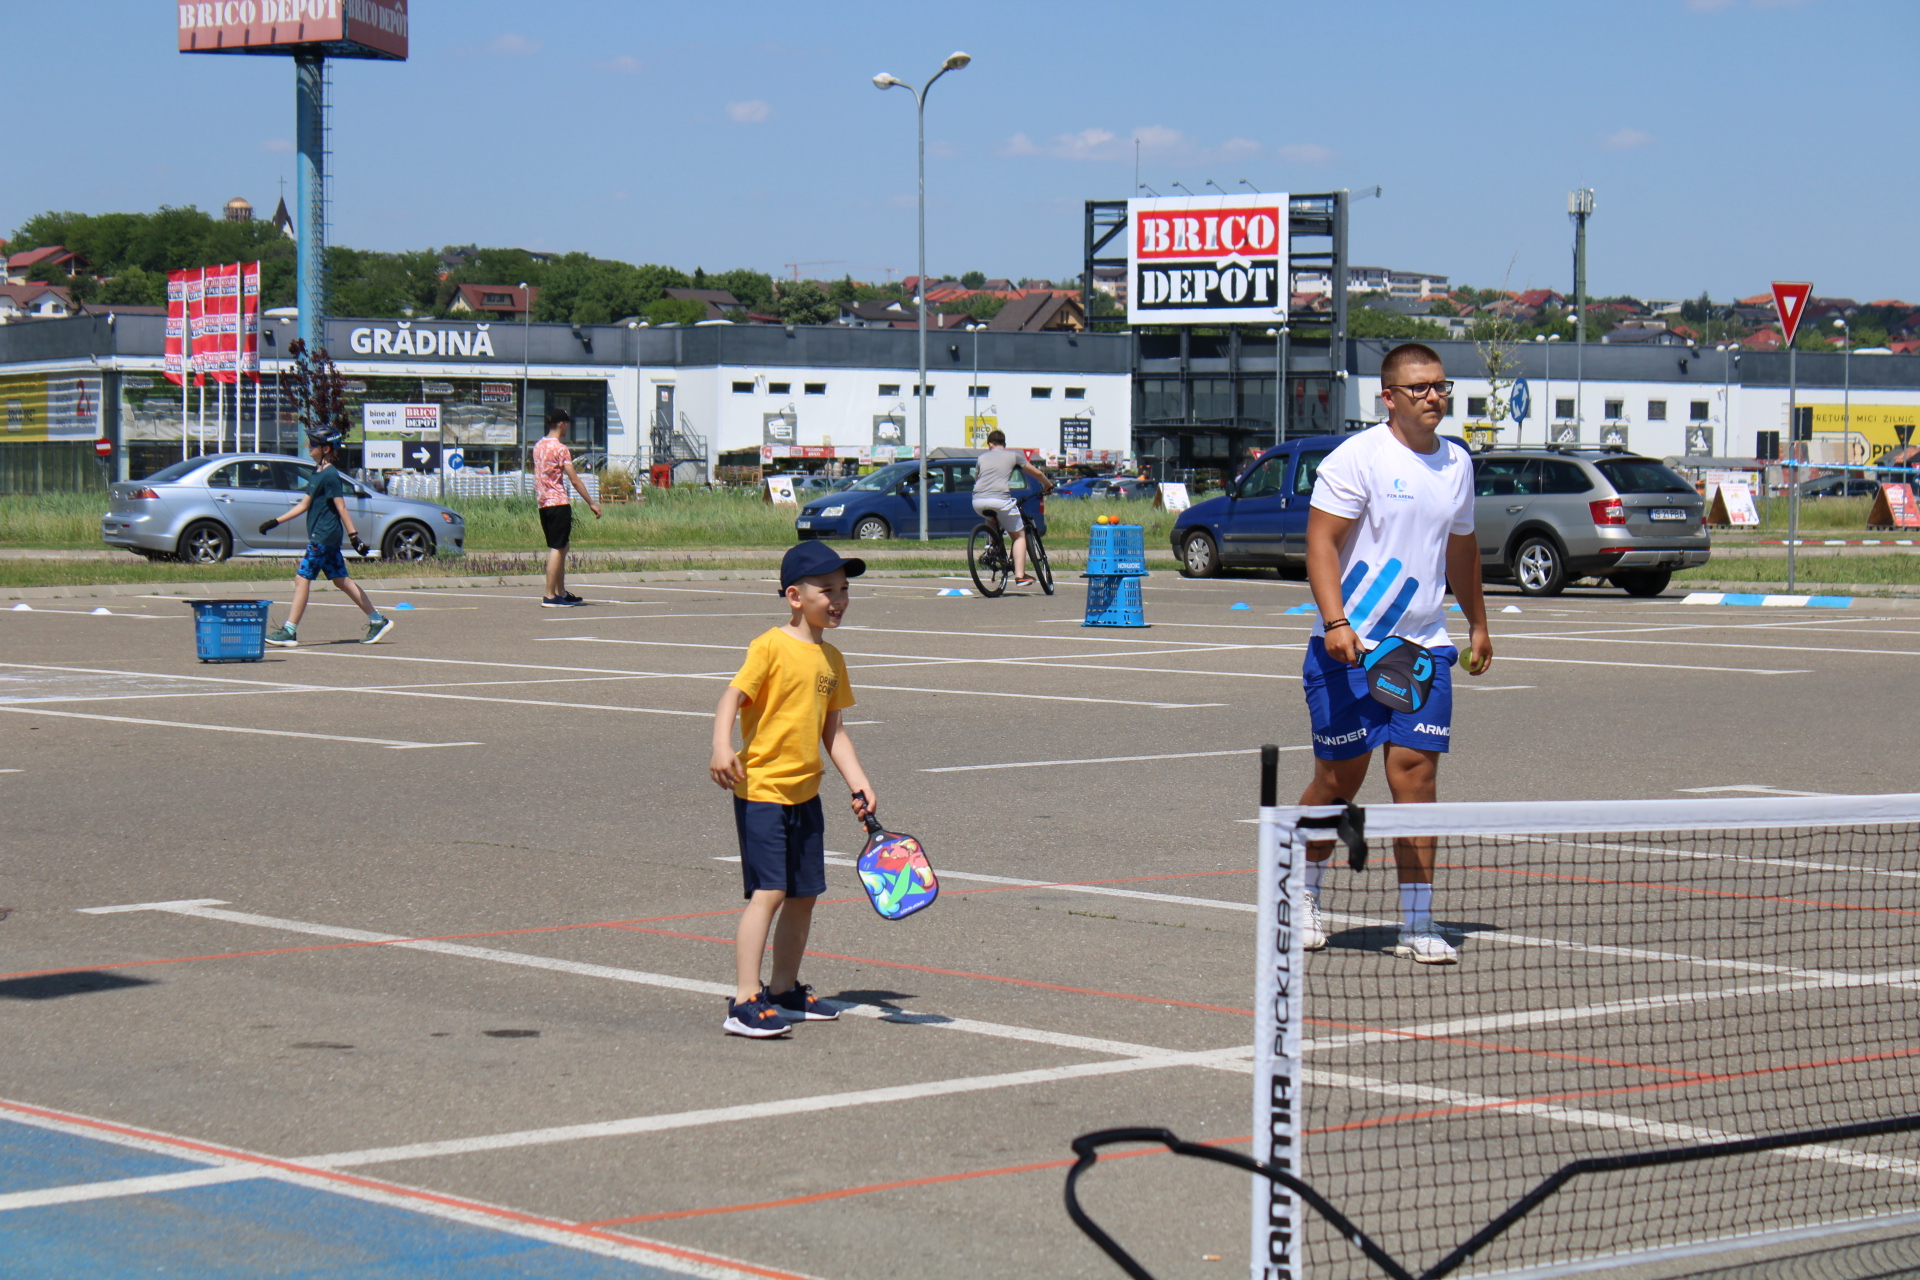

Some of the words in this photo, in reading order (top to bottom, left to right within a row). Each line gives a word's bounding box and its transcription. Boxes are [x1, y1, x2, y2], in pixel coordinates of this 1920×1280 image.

[179, 0, 256, 28] BRICO
[348, 0, 378, 27] BRICO
[1142, 215, 1275, 252] BRICO
[1142, 252, 1275, 303] DEPÔT
[350, 321, 495, 357] GRĂDINĂ
[406, 408, 436, 416] BRICO
[1856, 414, 1877, 423] MICI
[1883, 415, 1914, 424] ZILNIC
[1274, 831, 1292, 1058] PICKLEBALL
